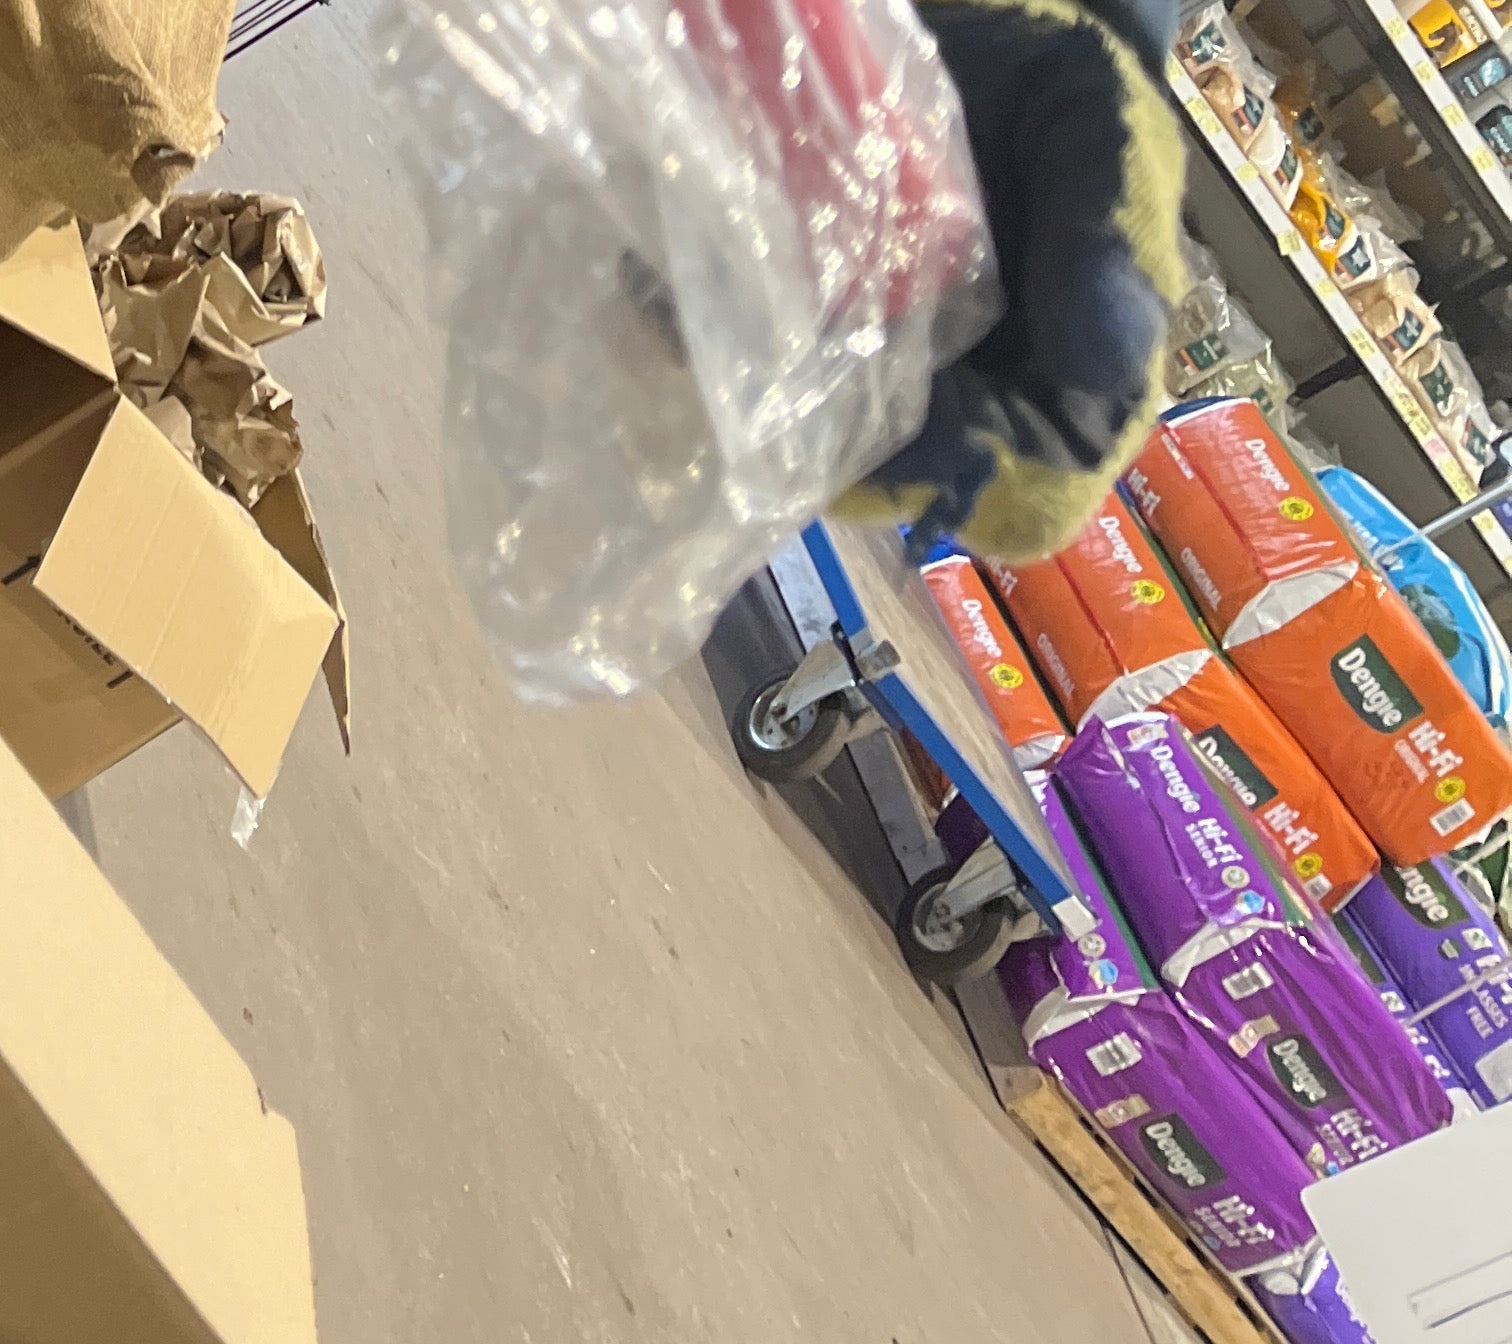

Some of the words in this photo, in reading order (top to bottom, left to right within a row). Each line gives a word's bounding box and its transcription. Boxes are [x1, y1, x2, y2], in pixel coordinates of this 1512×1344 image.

[1245, 438, 1290, 491] Dengie
[1098, 516, 1142, 573] Dengie
[1181, 547, 1222, 611] ORIGINAL
[962, 599, 1002, 658] Dengie
[1037, 633, 1076, 698] ORIGINAL
[1338, 647, 1402, 728] Dengie
[1408, 721, 1464, 778] Hi-Fi
[1150, 743, 1201, 813] Dengie
[1198, 817, 1243, 864] Hi-Fi
[1264, 802, 1319, 854] Hi-Fi
[1185, 822, 1218, 869] SENIOR
[1394, 866, 1449, 922] ngie
[1466, 1005, 1494, 1039] FREE
[1273, 1039, 1327, 1103] Dengie
[1145, 1121, 1206, 1187] Dengie
[1330, 1109, 1389, 1160] Hi-Fi
[1194, 1206, 1241, 1248] SENIOR
[1213, 1195, 1275, 1245] Hi-Fi
